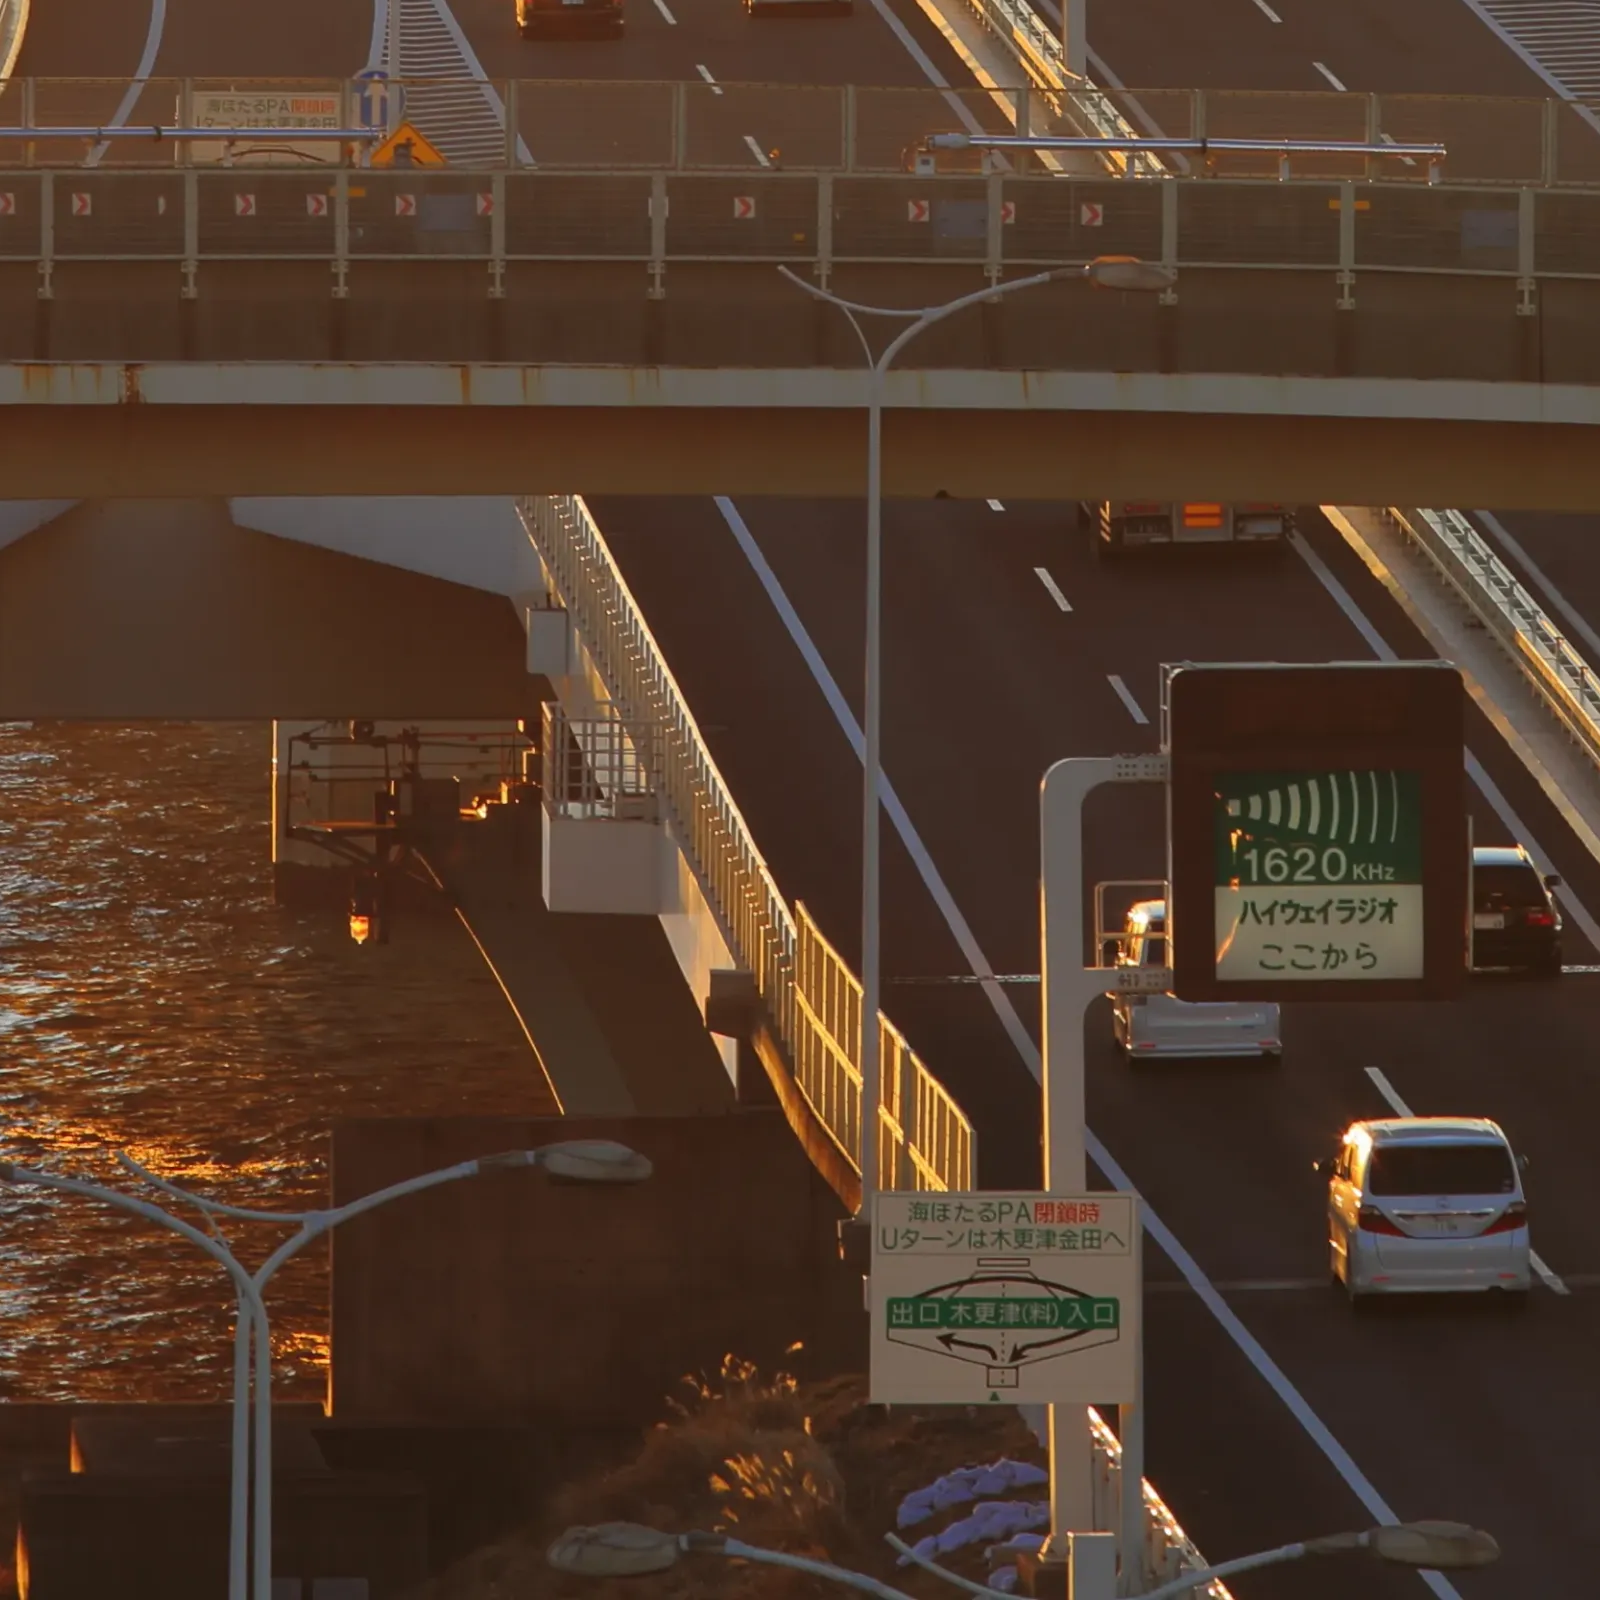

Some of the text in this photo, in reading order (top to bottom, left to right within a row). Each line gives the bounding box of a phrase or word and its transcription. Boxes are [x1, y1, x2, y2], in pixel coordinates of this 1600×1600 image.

[1244, 848, 1395, 882] 1620 KHz
[1239, 898, 1398, 925] ハイウェイラジオ
[1259, 942, 1378, 970] ここから
[892, 1303, 940, 1324] 出口
[1067, 1302, 1114, 1324] 入口
